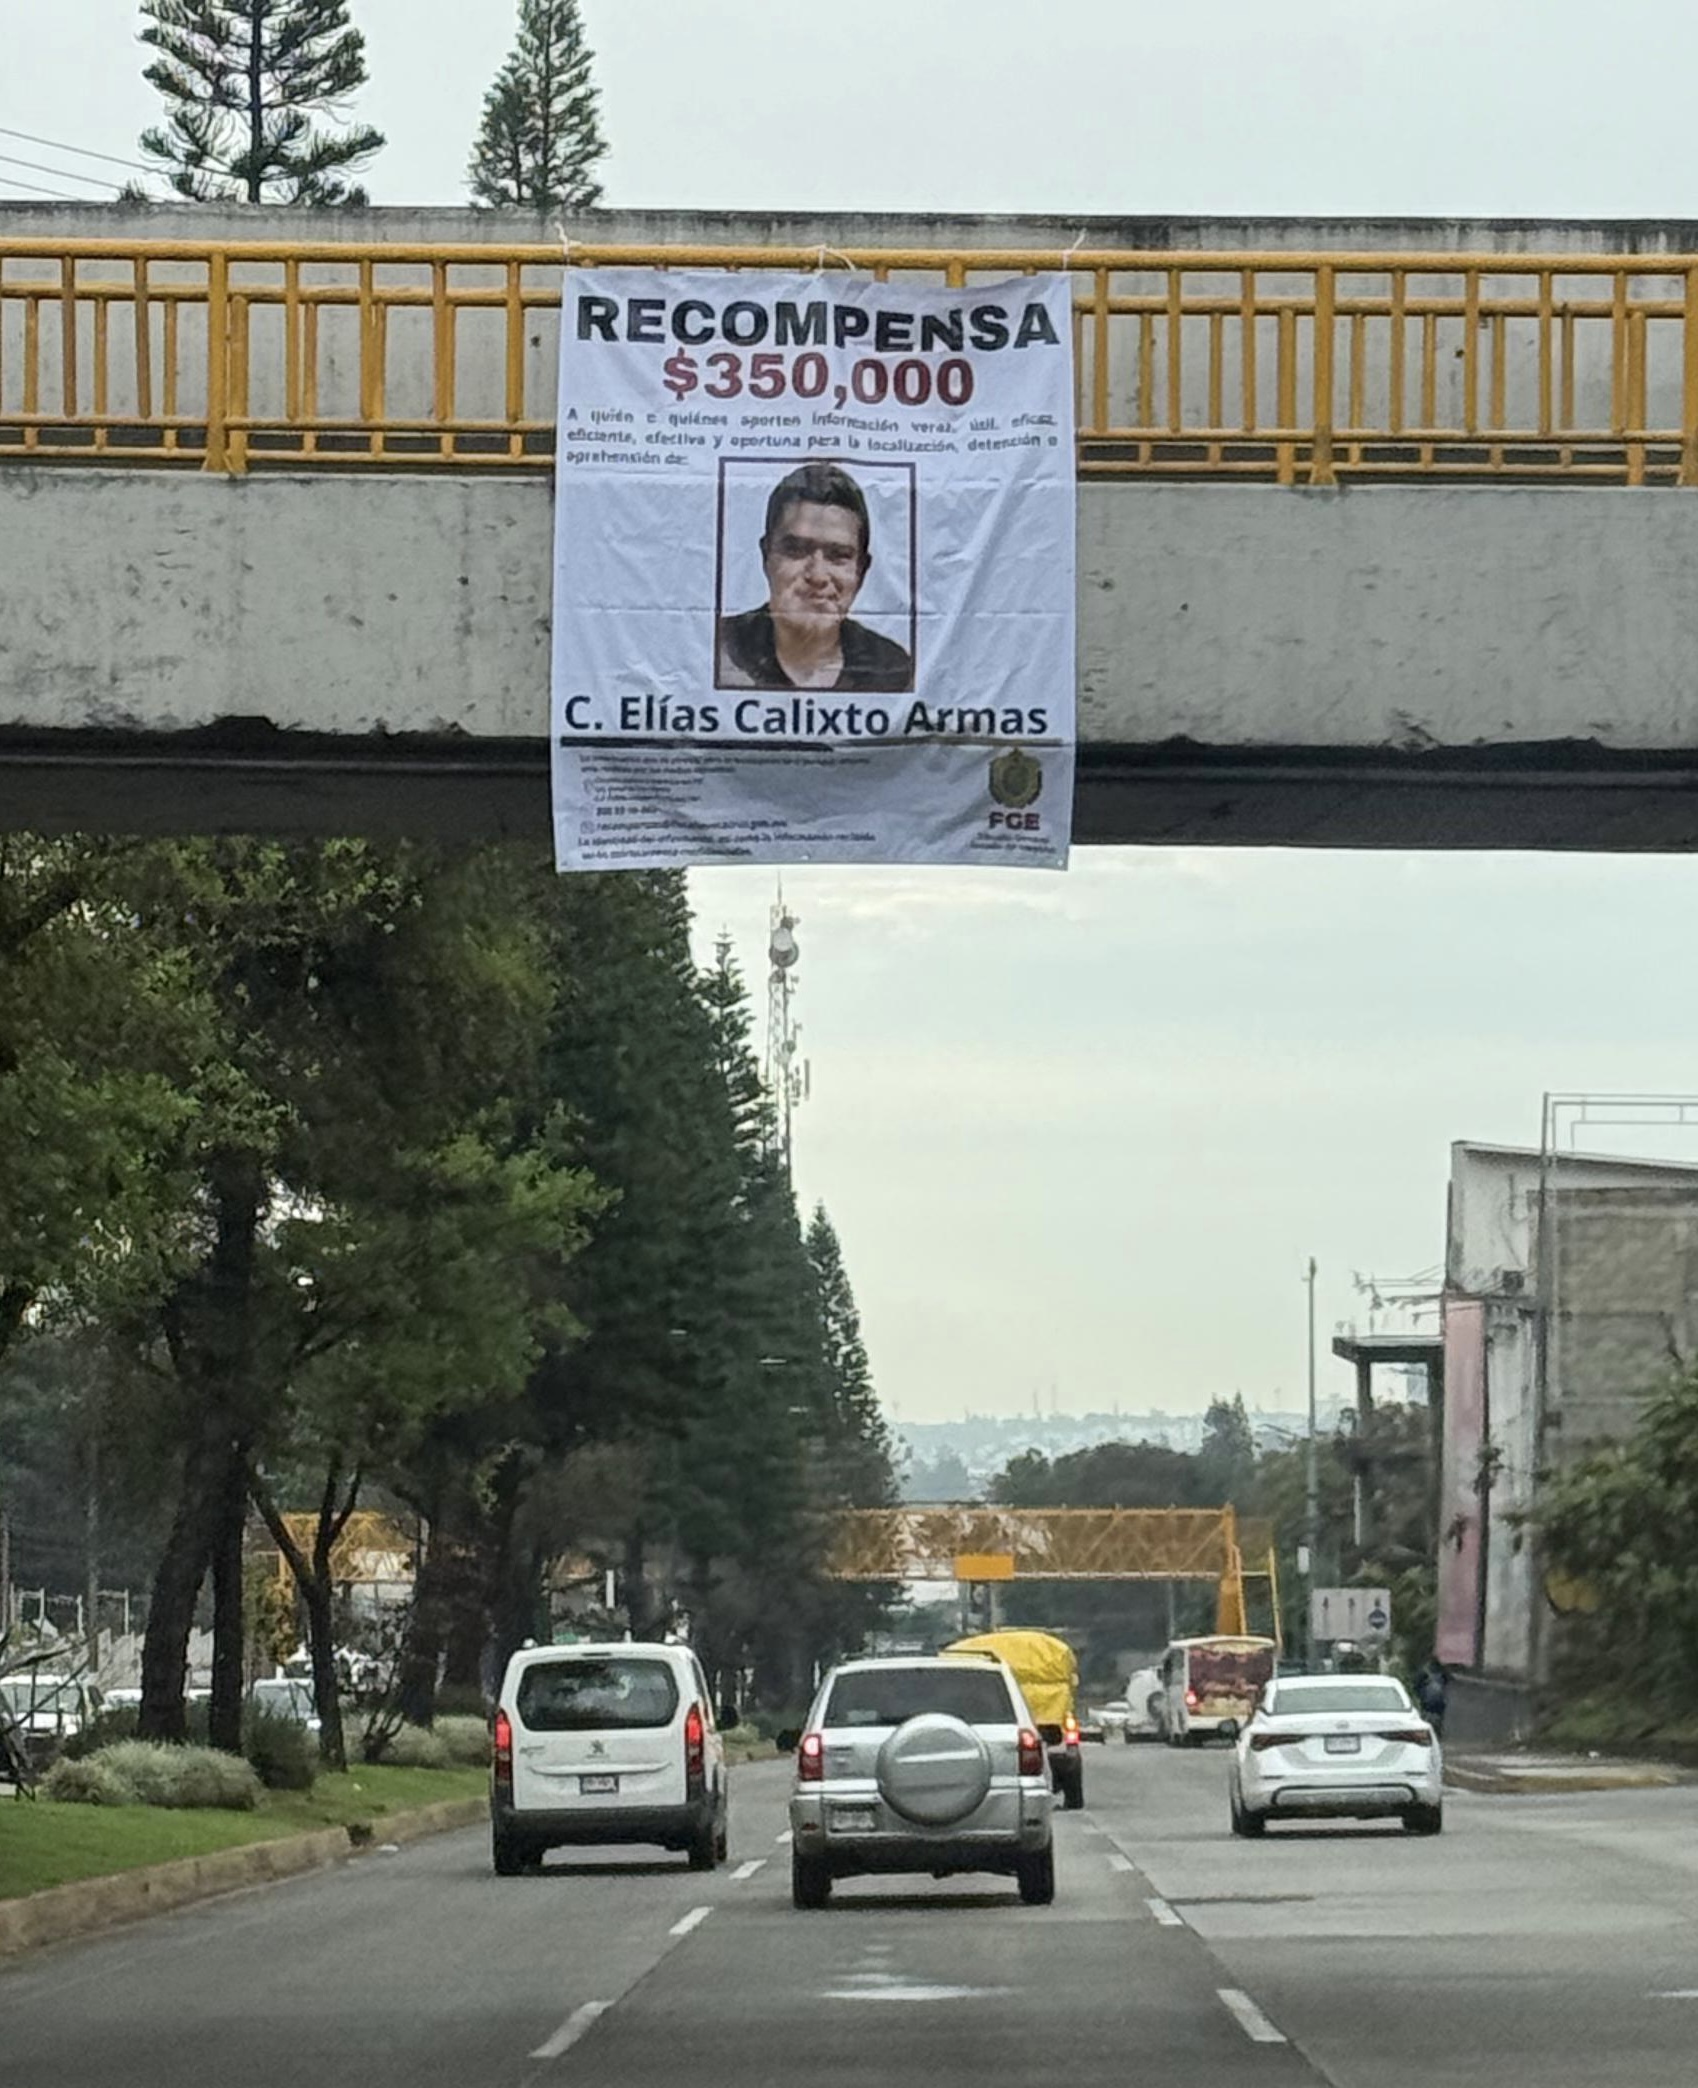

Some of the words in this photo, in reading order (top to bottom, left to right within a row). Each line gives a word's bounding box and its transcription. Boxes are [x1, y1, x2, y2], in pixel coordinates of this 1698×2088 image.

[577, 296, 1060, 352] RECOMPENSA
[663, 347, 974, 409] $350,000
[567, 407, 578, 421] A
[812, 412, 899, 432] información
[645, 430, 706, 446] efectiva
[713, 435, 723, 449] y
[730, 435, 801, 449] oportuna
[848, 435, 860, 449] la
[967, 432, 1041, 451] detención
[564, 695, 602, 732] C.
[620, 693, 720, 733] Elías
[735, 696, 890, 736] Calixto
[903, 697, 1048, 736] Armas
[989, 811, 1040, 831] FGE
